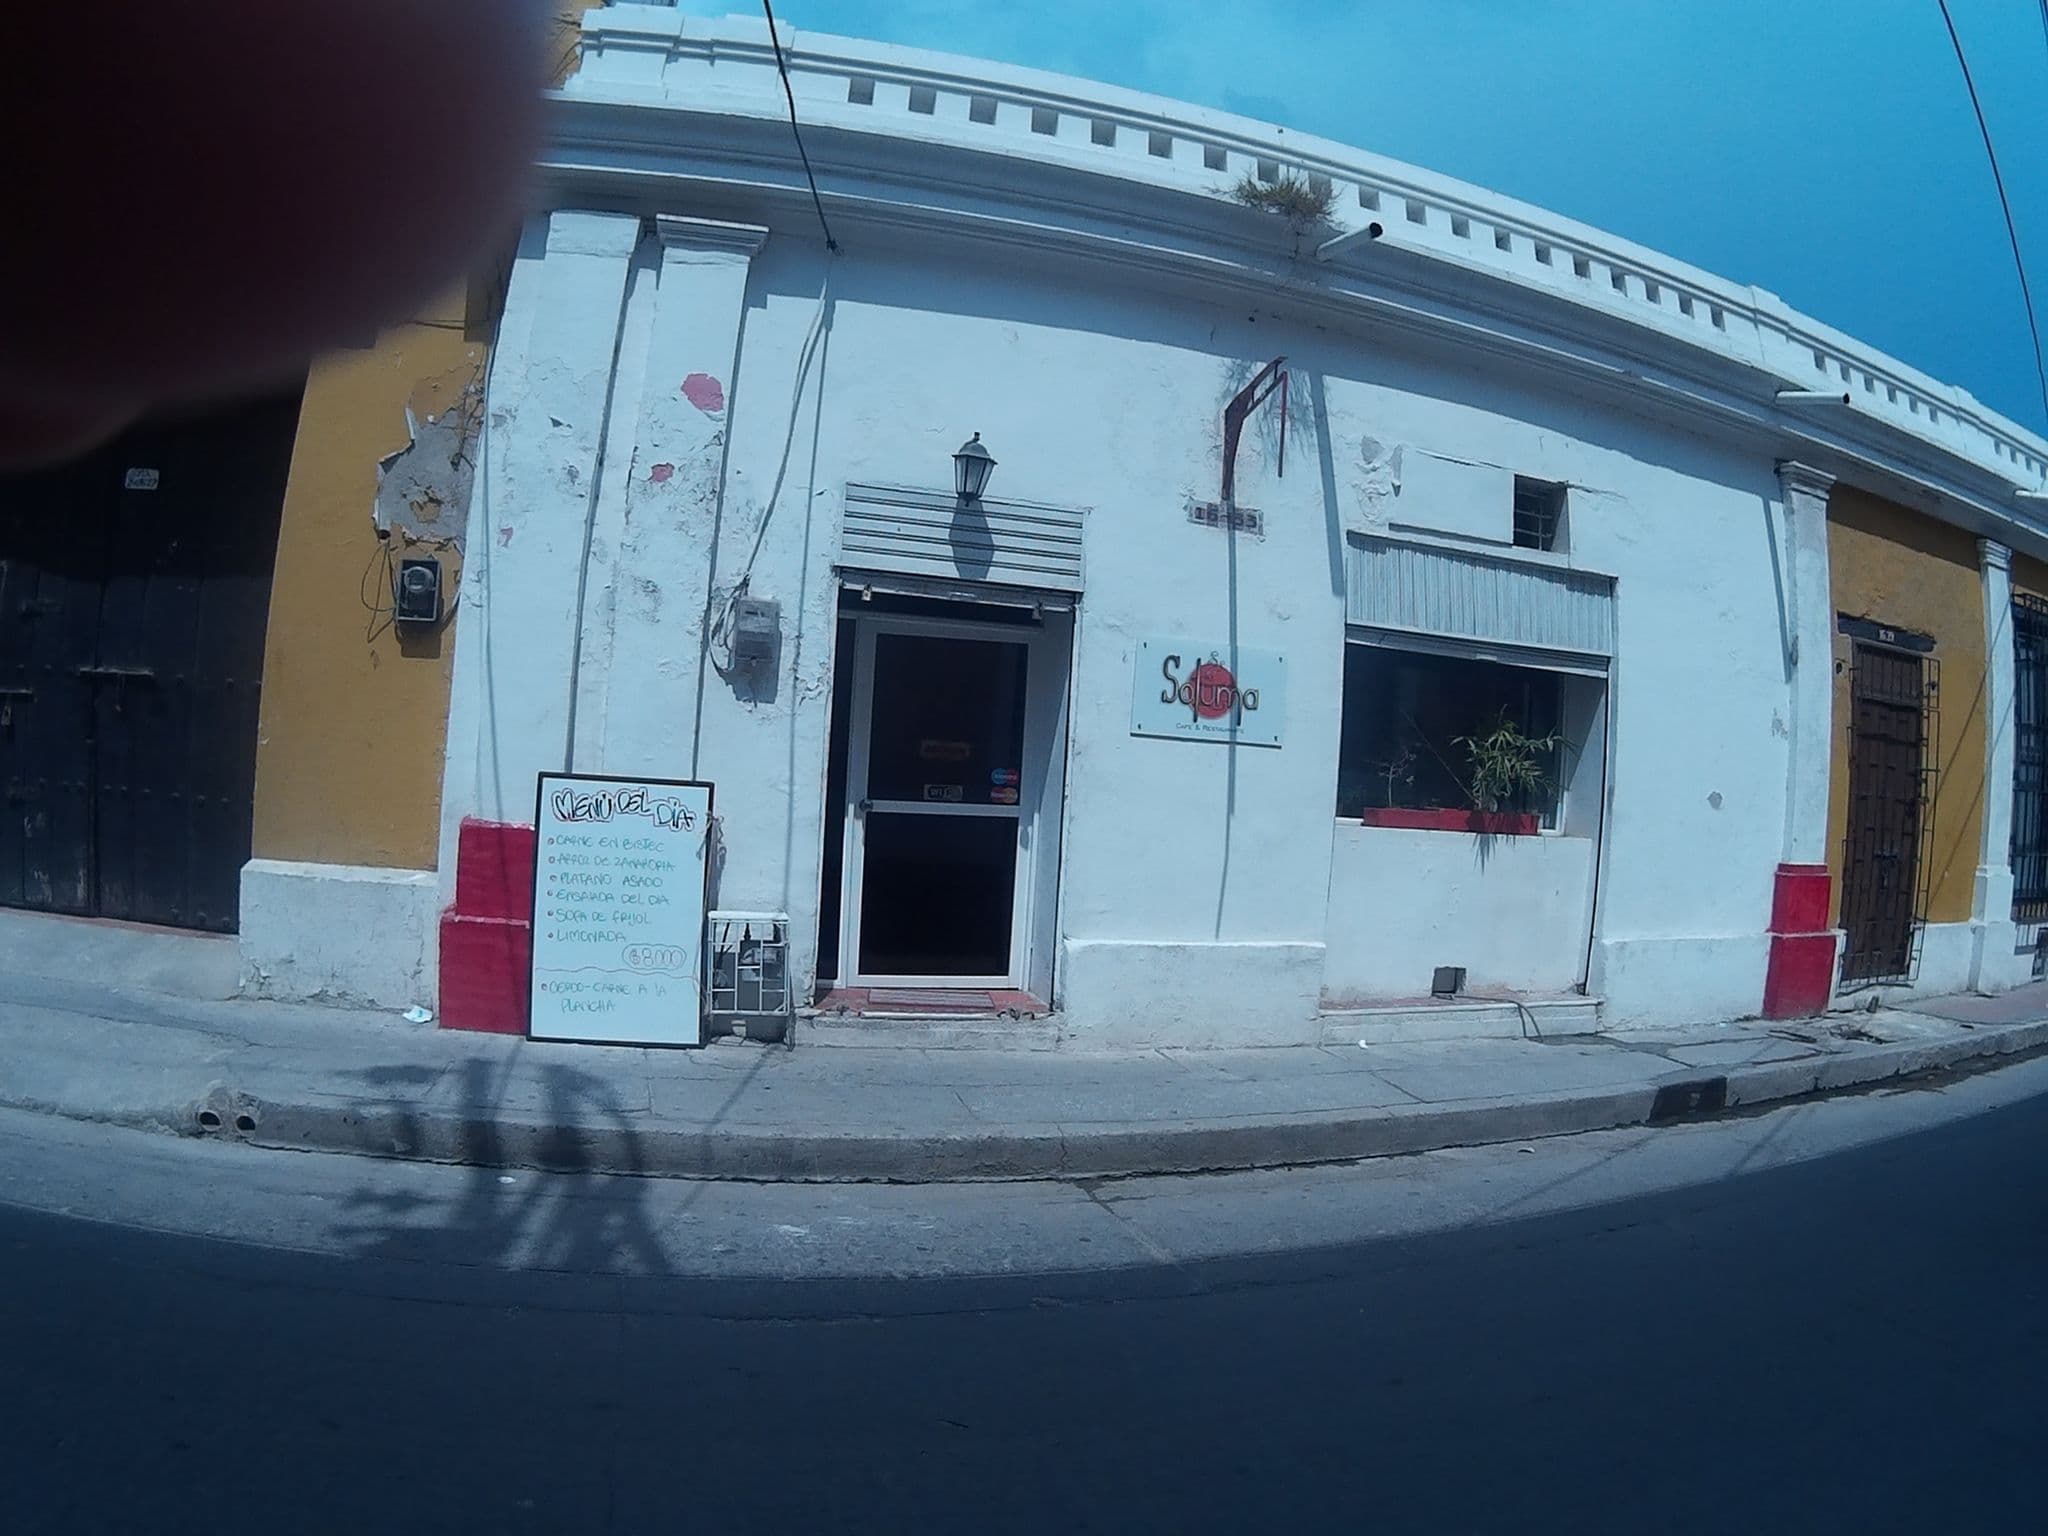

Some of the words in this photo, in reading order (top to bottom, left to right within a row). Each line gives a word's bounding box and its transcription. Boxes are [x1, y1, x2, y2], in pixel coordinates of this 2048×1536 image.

[616, 788, 651, 814] DEL
[556, 834, 593, 848] CARNE
[598, 836, 619, 848] EN
[622, 838, 665, 853] BISTEC
[557, 853, 589, 865] ARROZ
[593, 855, 609, 867] DE
[622, 874, 663, 887] ASADO
[556, 889, 615, 903] ENSALADA
[621, 893, 645, 904] DEL
[556, 908, 588, 923] SOPA
[591, 911, 606, 922] DE
[612, 911, 652, 927] FRIJOL
[556, 929, 626, 943] LIMONADA
[638, 984, 648, 994] A
[561, 999, 616, 1013] PLANCHA
